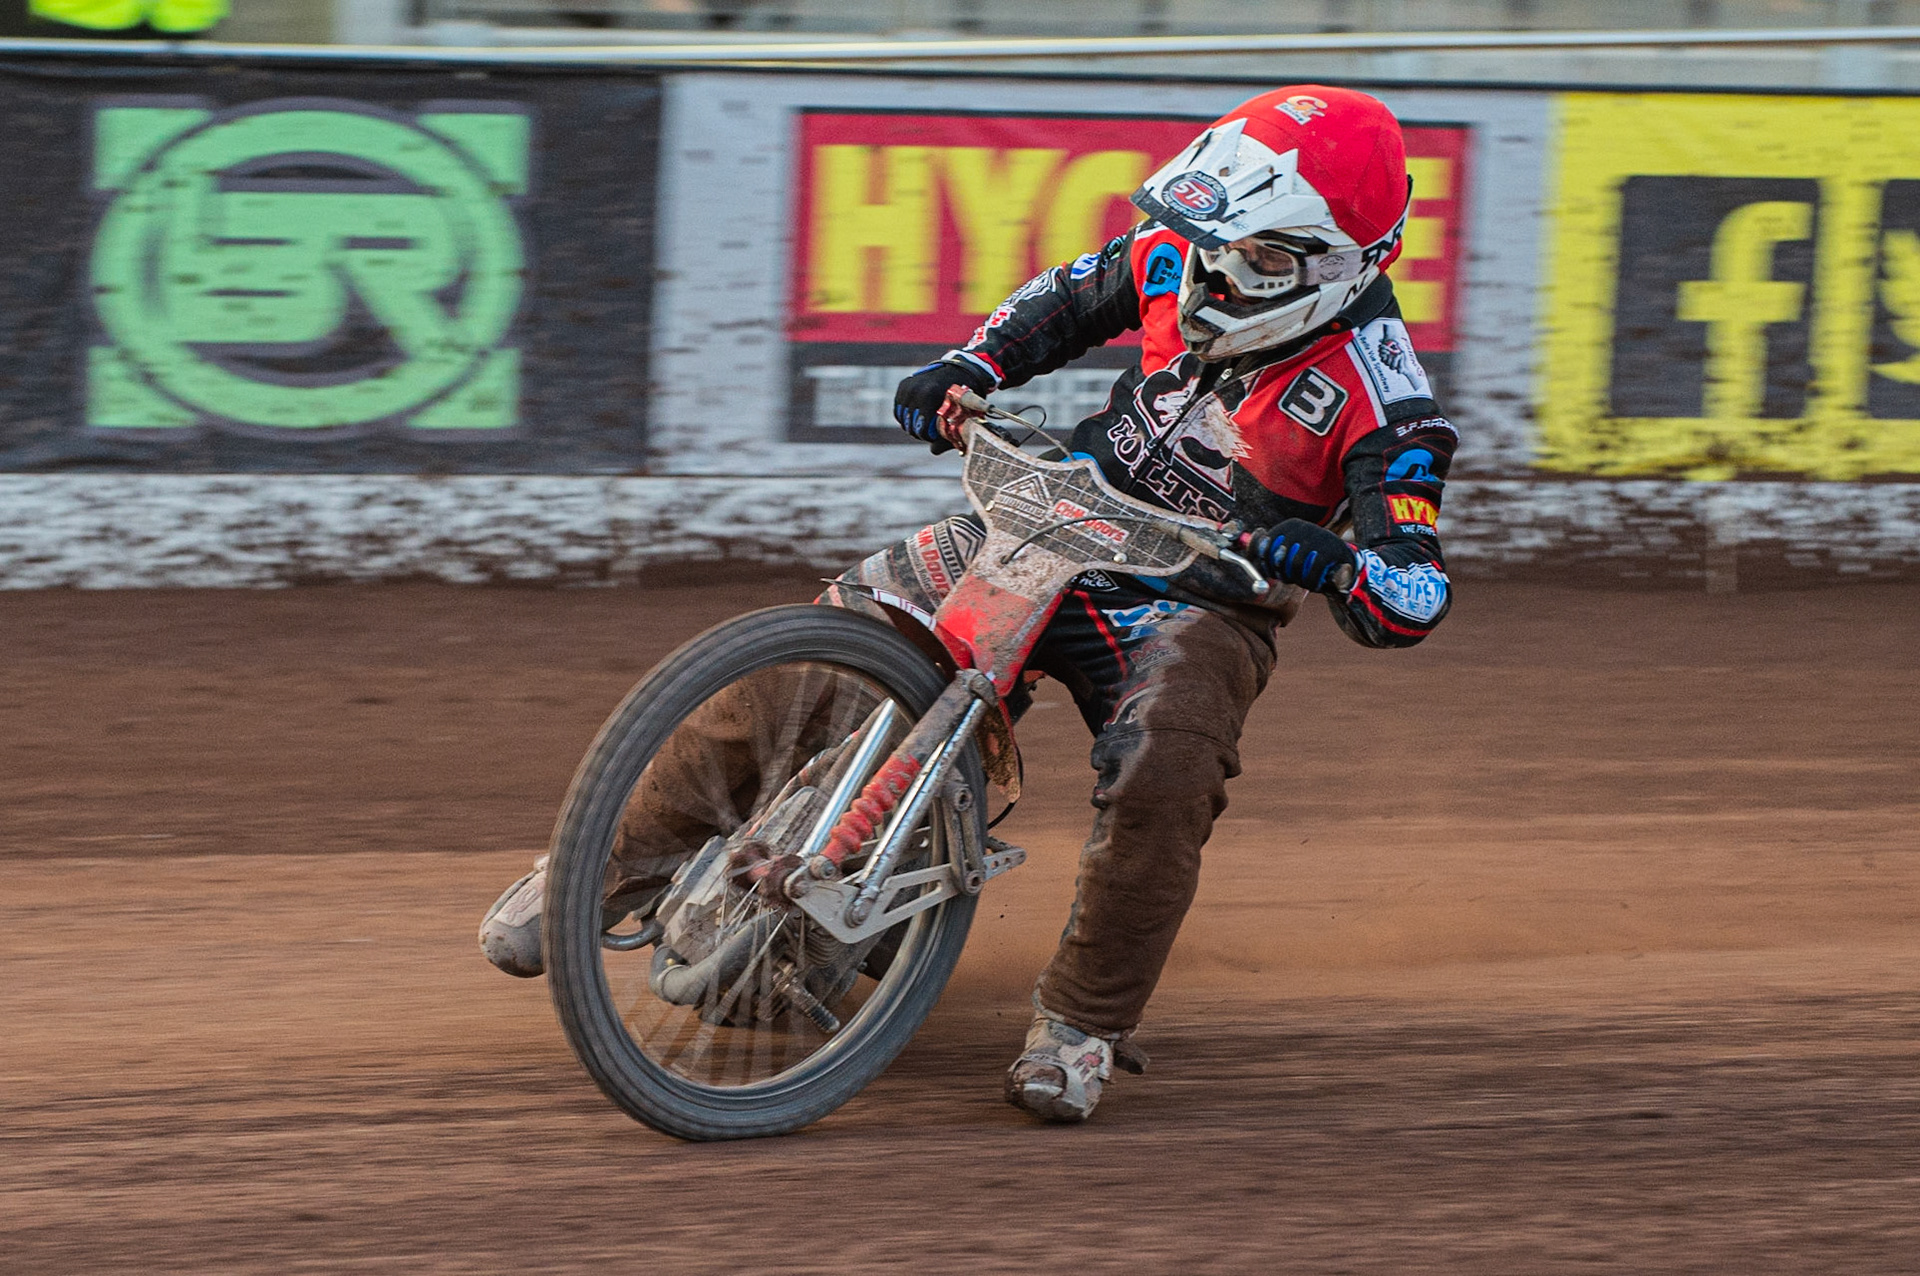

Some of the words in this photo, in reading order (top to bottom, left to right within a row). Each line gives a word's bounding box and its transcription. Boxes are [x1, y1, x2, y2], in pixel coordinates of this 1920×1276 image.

[1173, 181, 1216, 208] STS
[1368, 350, 1377, 362] Vue
[1373, 362, 1390, 393] Speedway
